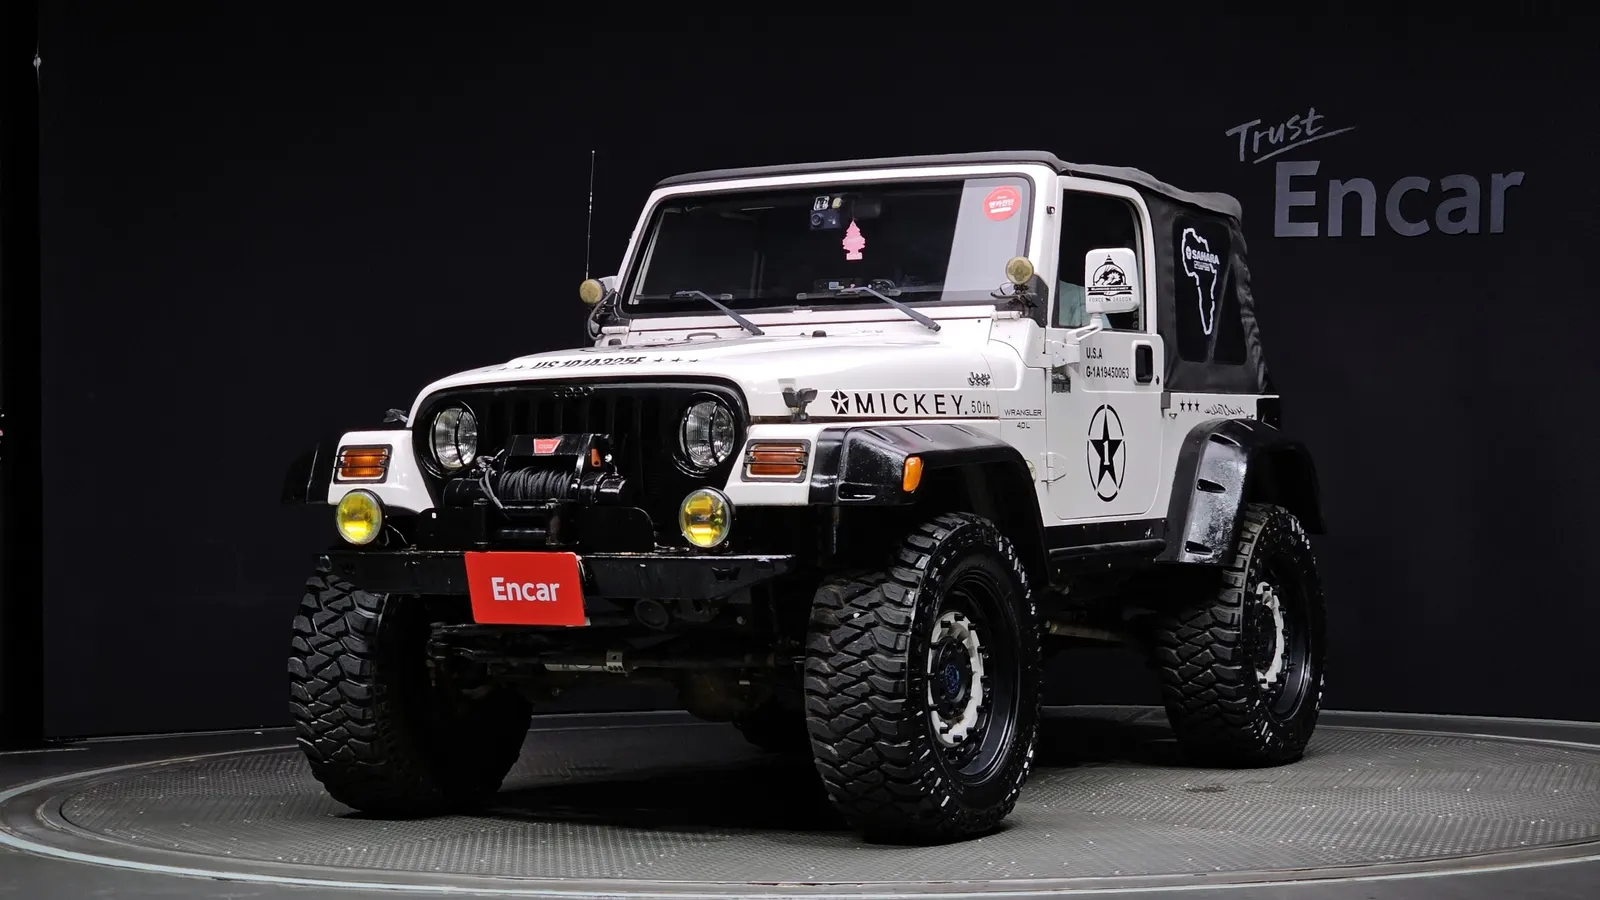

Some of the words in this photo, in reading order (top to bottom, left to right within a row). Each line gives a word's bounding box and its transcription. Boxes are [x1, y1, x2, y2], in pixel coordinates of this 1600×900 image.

[1225, 107, 1325, 162] Trust
[1274, 160, 1525, 237] Encar
[971, 400, 992, 414] 50th
[1004, 408, 1043, 417] WRANGLER
[1102, 440, 1111, 466] 1
[491, 577, 560, 602] Encar
